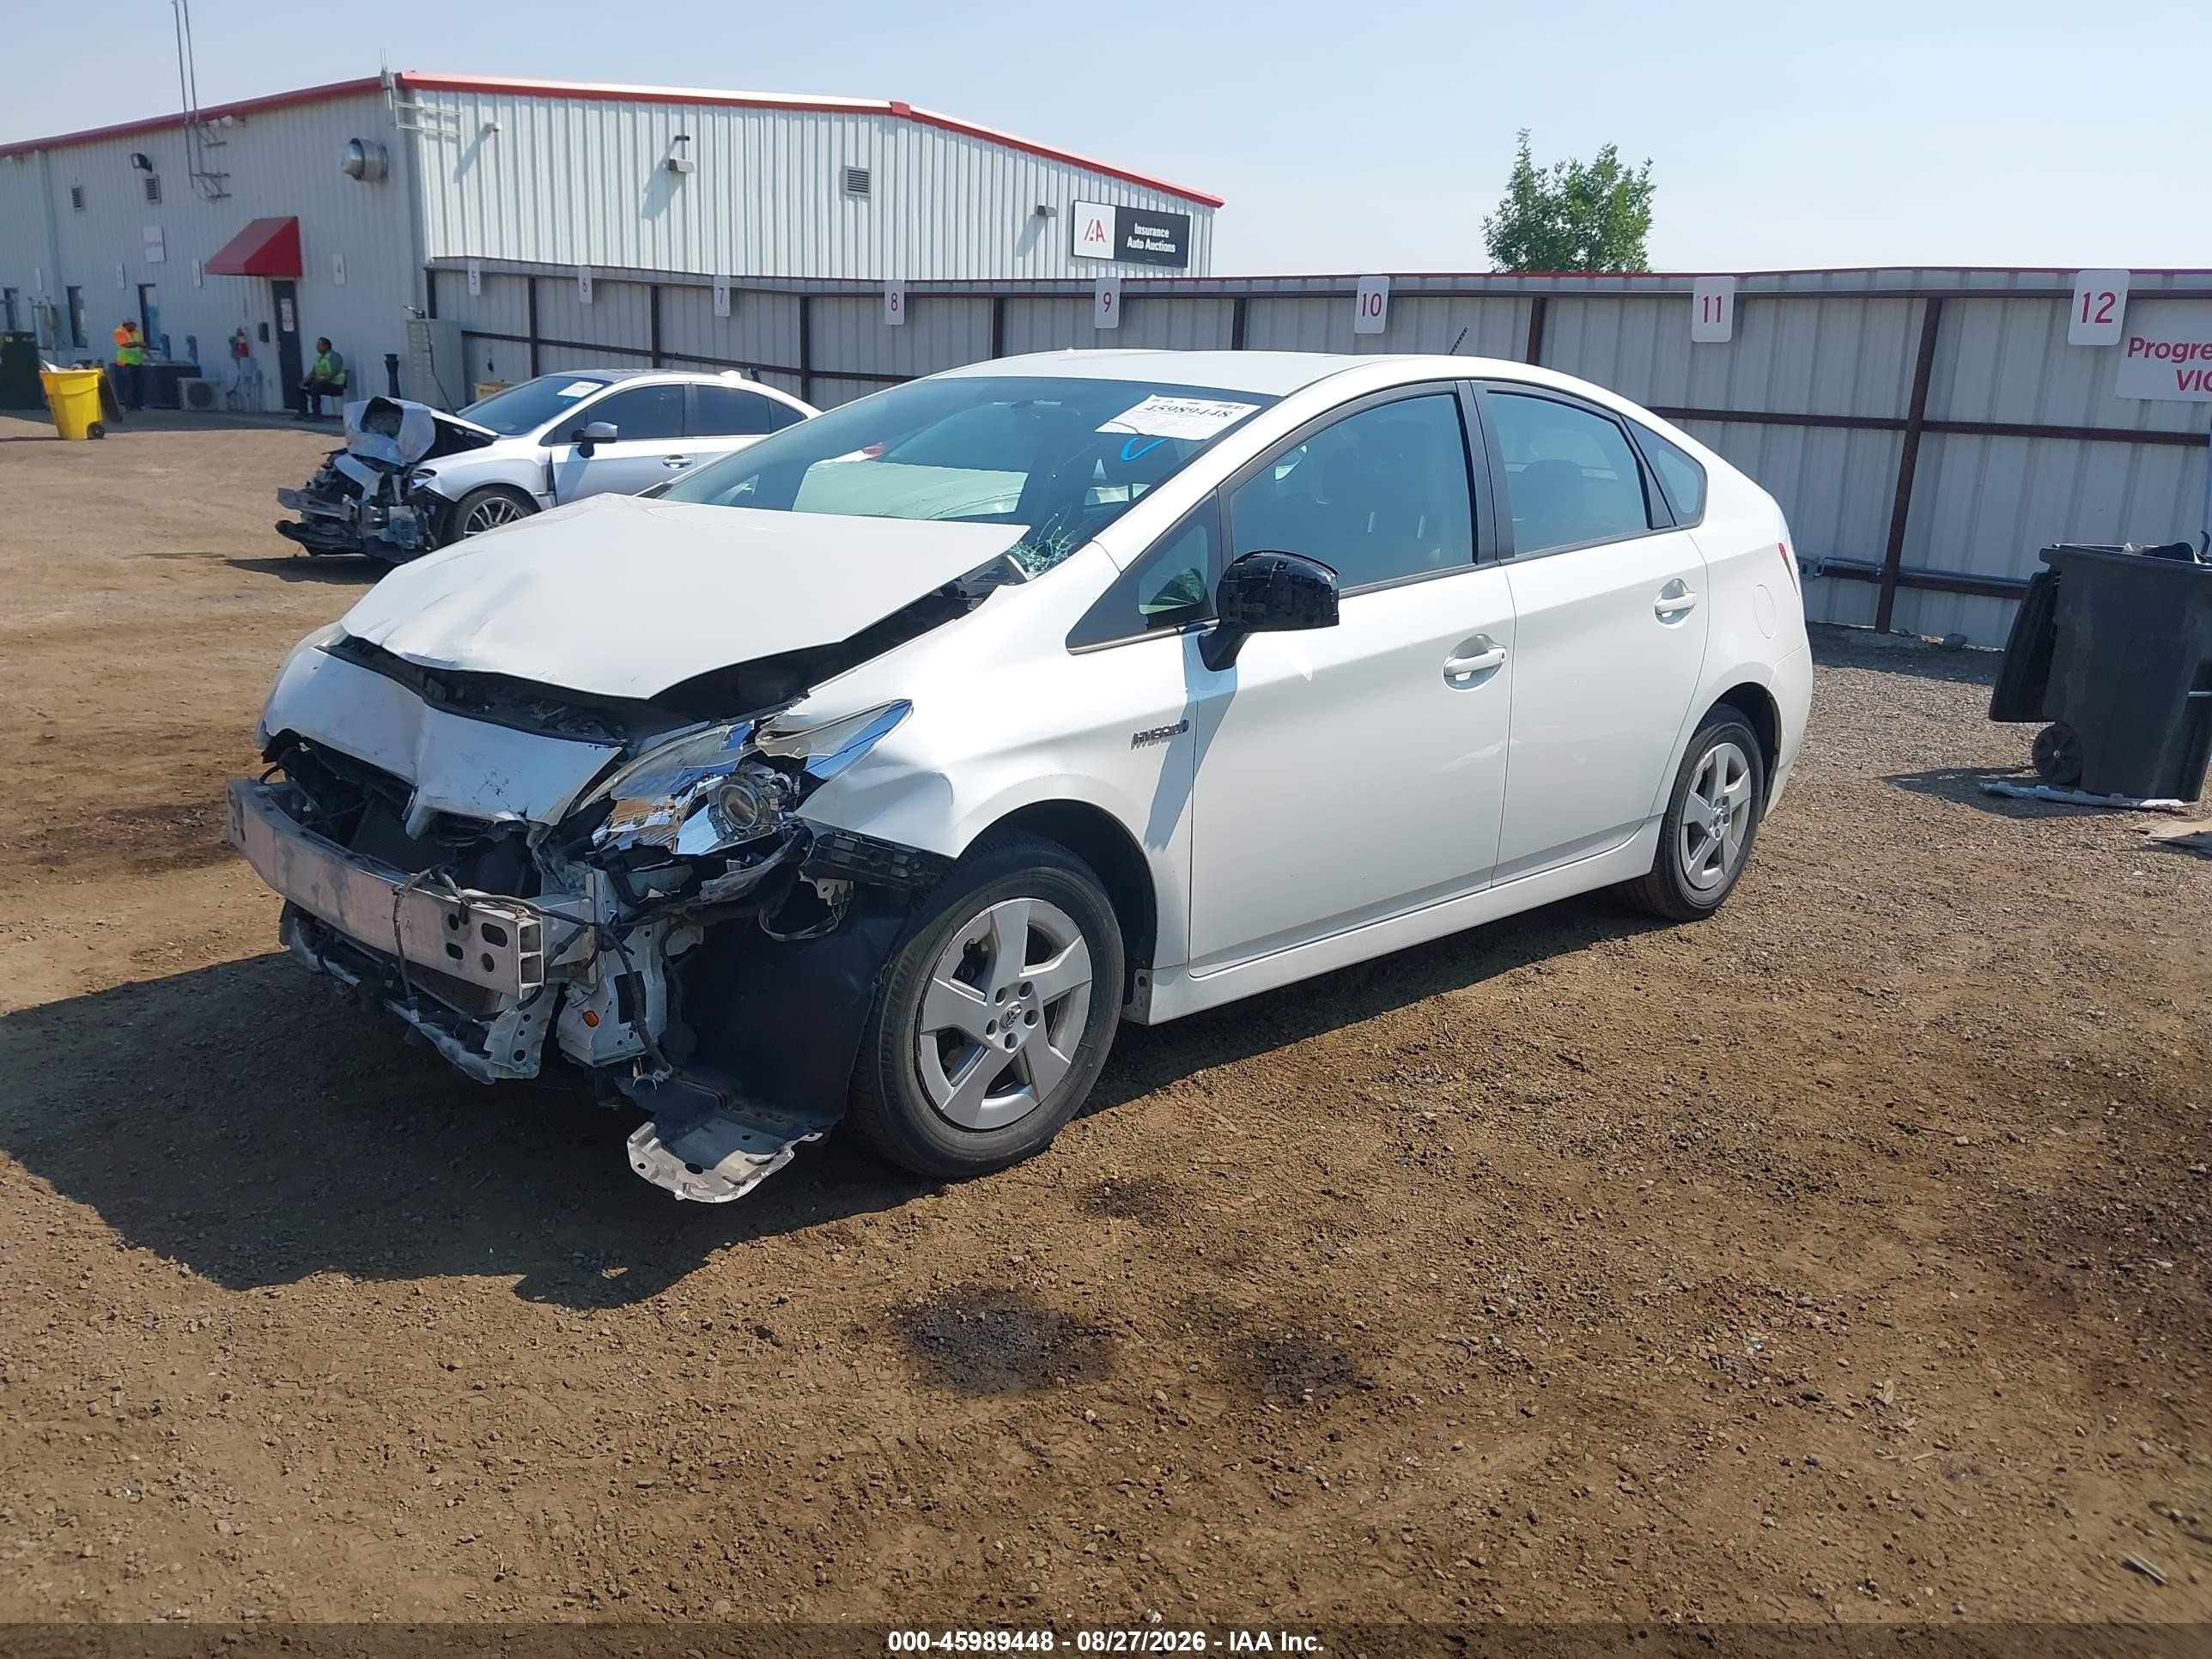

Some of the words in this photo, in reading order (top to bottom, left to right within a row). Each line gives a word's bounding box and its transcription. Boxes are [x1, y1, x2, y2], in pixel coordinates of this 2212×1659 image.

[1133, 222, 1170, 239] Insurance
[1127, 235, 1145, 250] Auto
[1145, 238, 1176, 253] Auctions
[718, 287, 726, 305] 7
[890, 292, 898, 312] 8
[1103, 292, 1112, 313] 9
[1362, 293, 1382, 317] 10
[1703, 295, 1722, 323] 11
[2081, 291, 2117, 324] 12
[1144, 404, 1234, 418] 45989448
